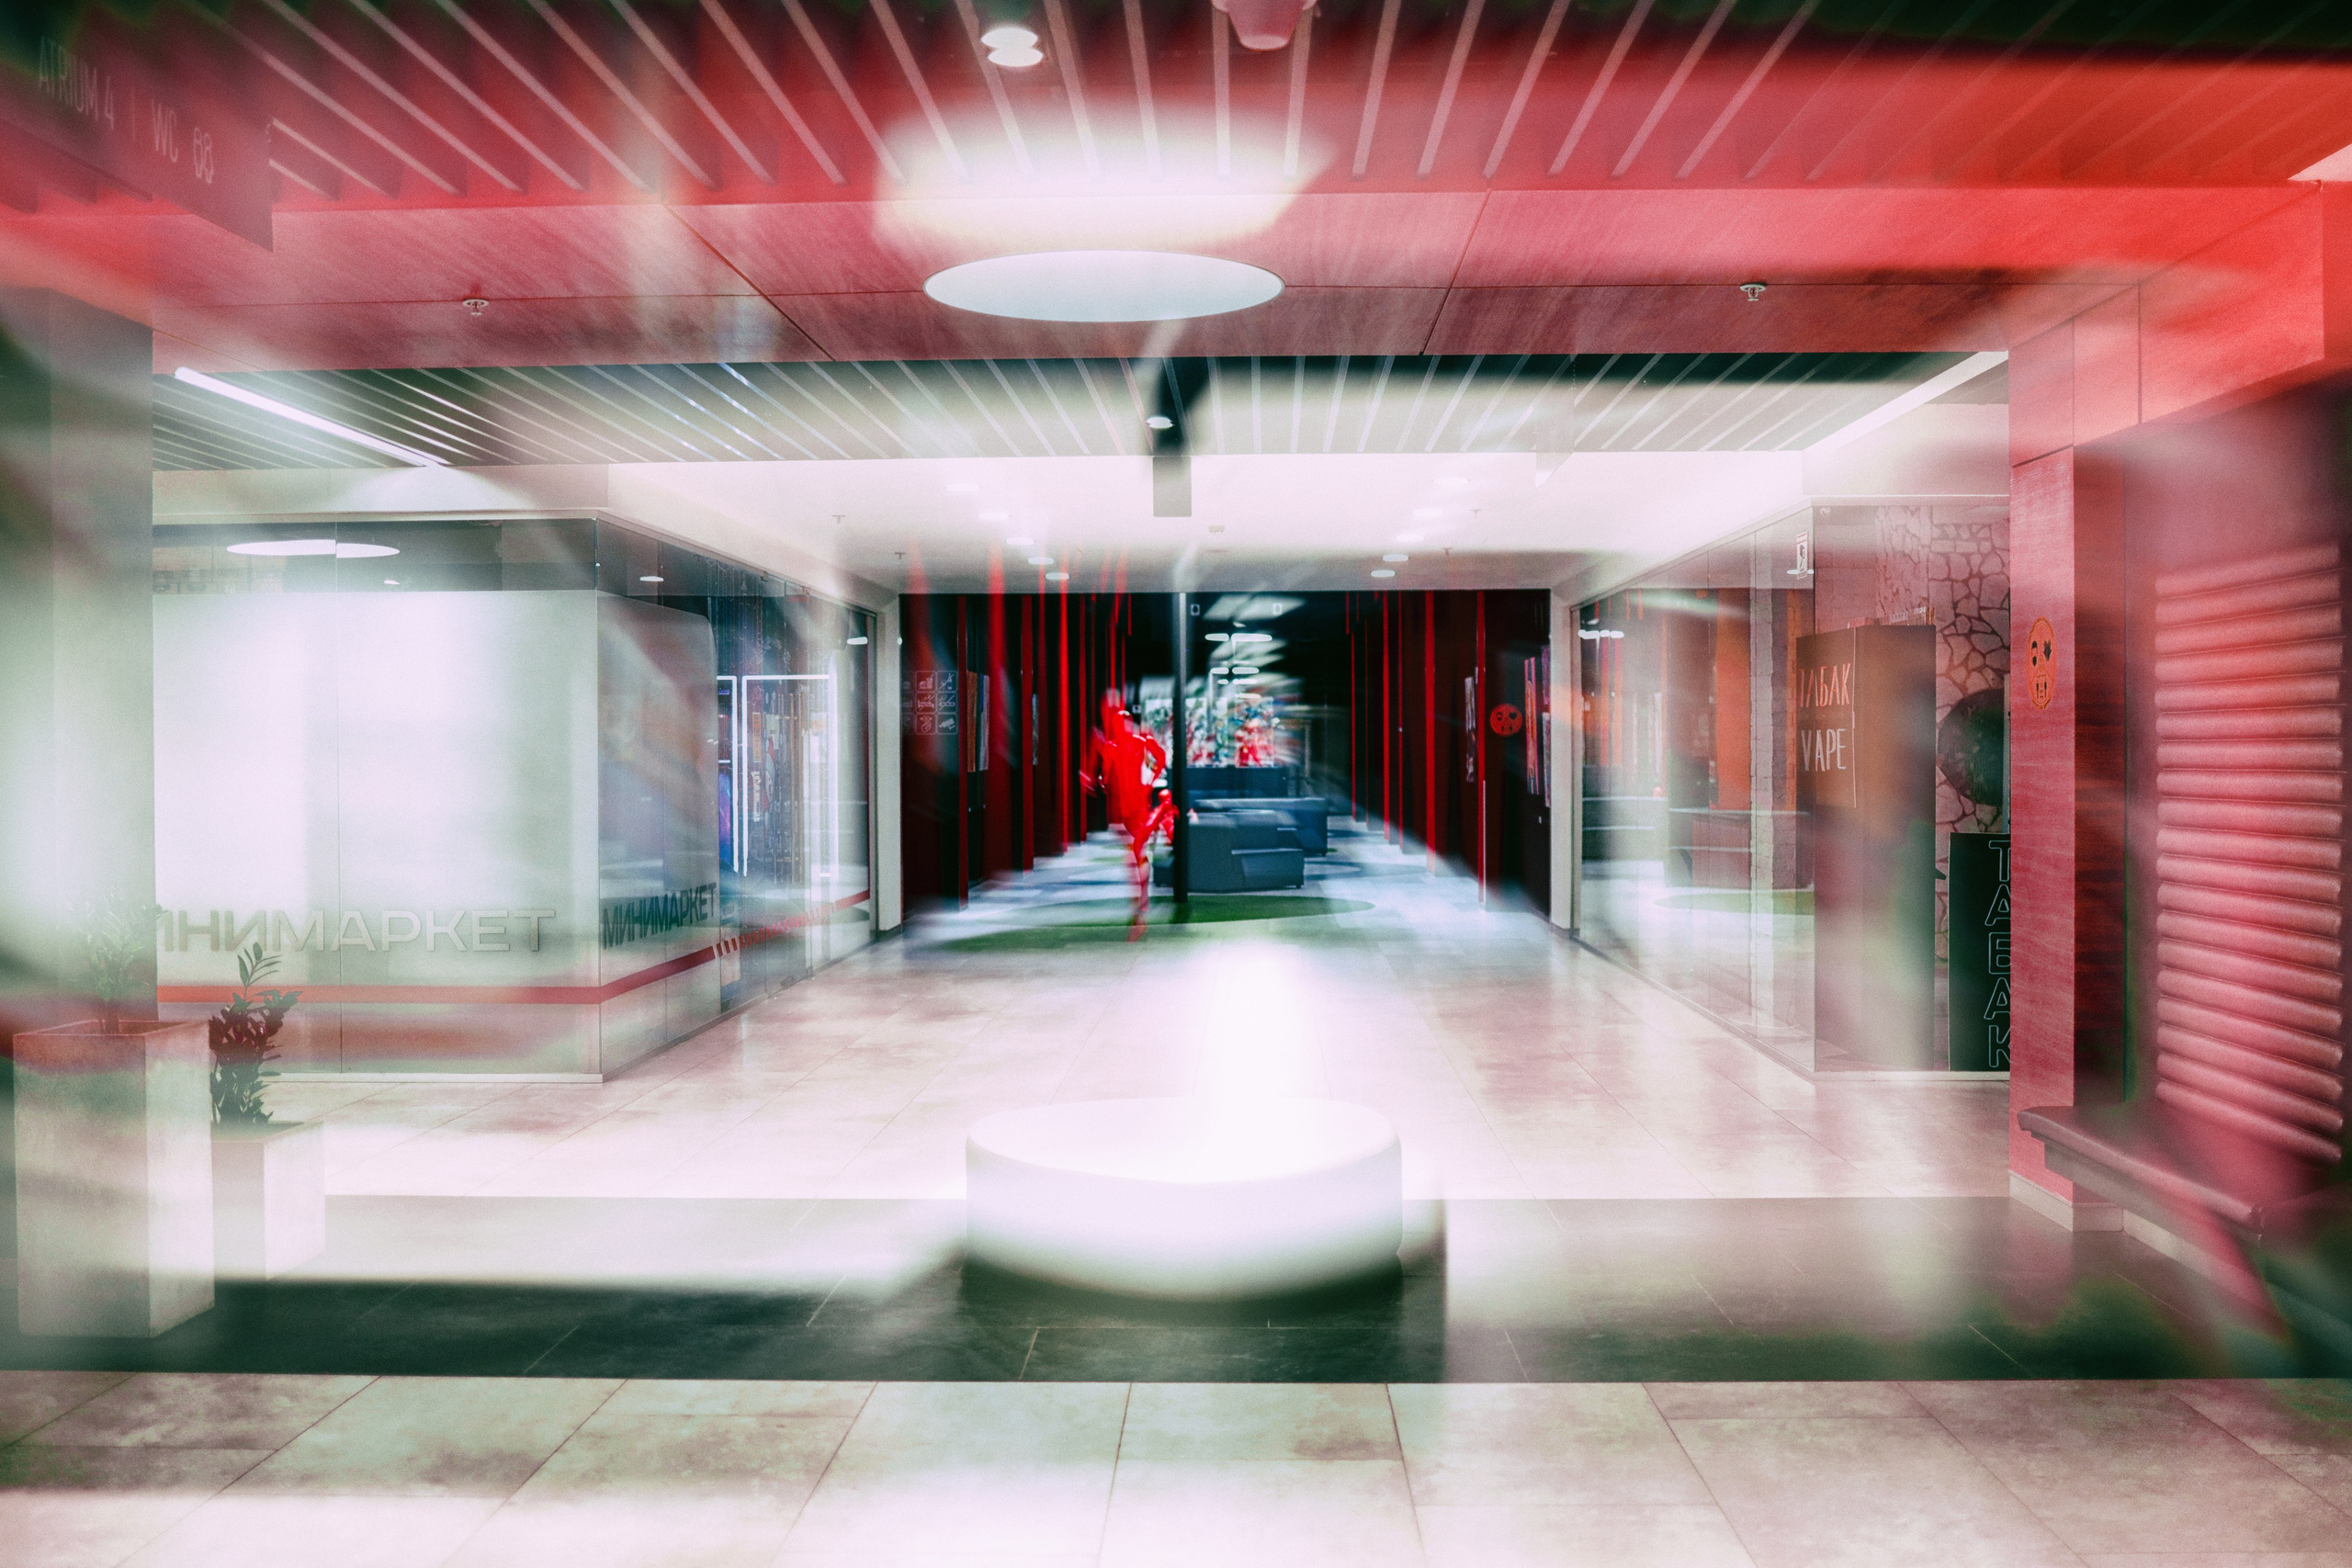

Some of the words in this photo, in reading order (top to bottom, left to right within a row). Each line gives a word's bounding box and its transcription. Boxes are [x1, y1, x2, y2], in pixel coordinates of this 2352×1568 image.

[104, 75, 115, 130] 4
[151, 99, 179, 164] WC
[1798, 662, 1852, 708] ТАБАК
[1800, 727, 1848, 773] VAPE
[603, 882, 718, 951] МИНИМАРКЕТ
